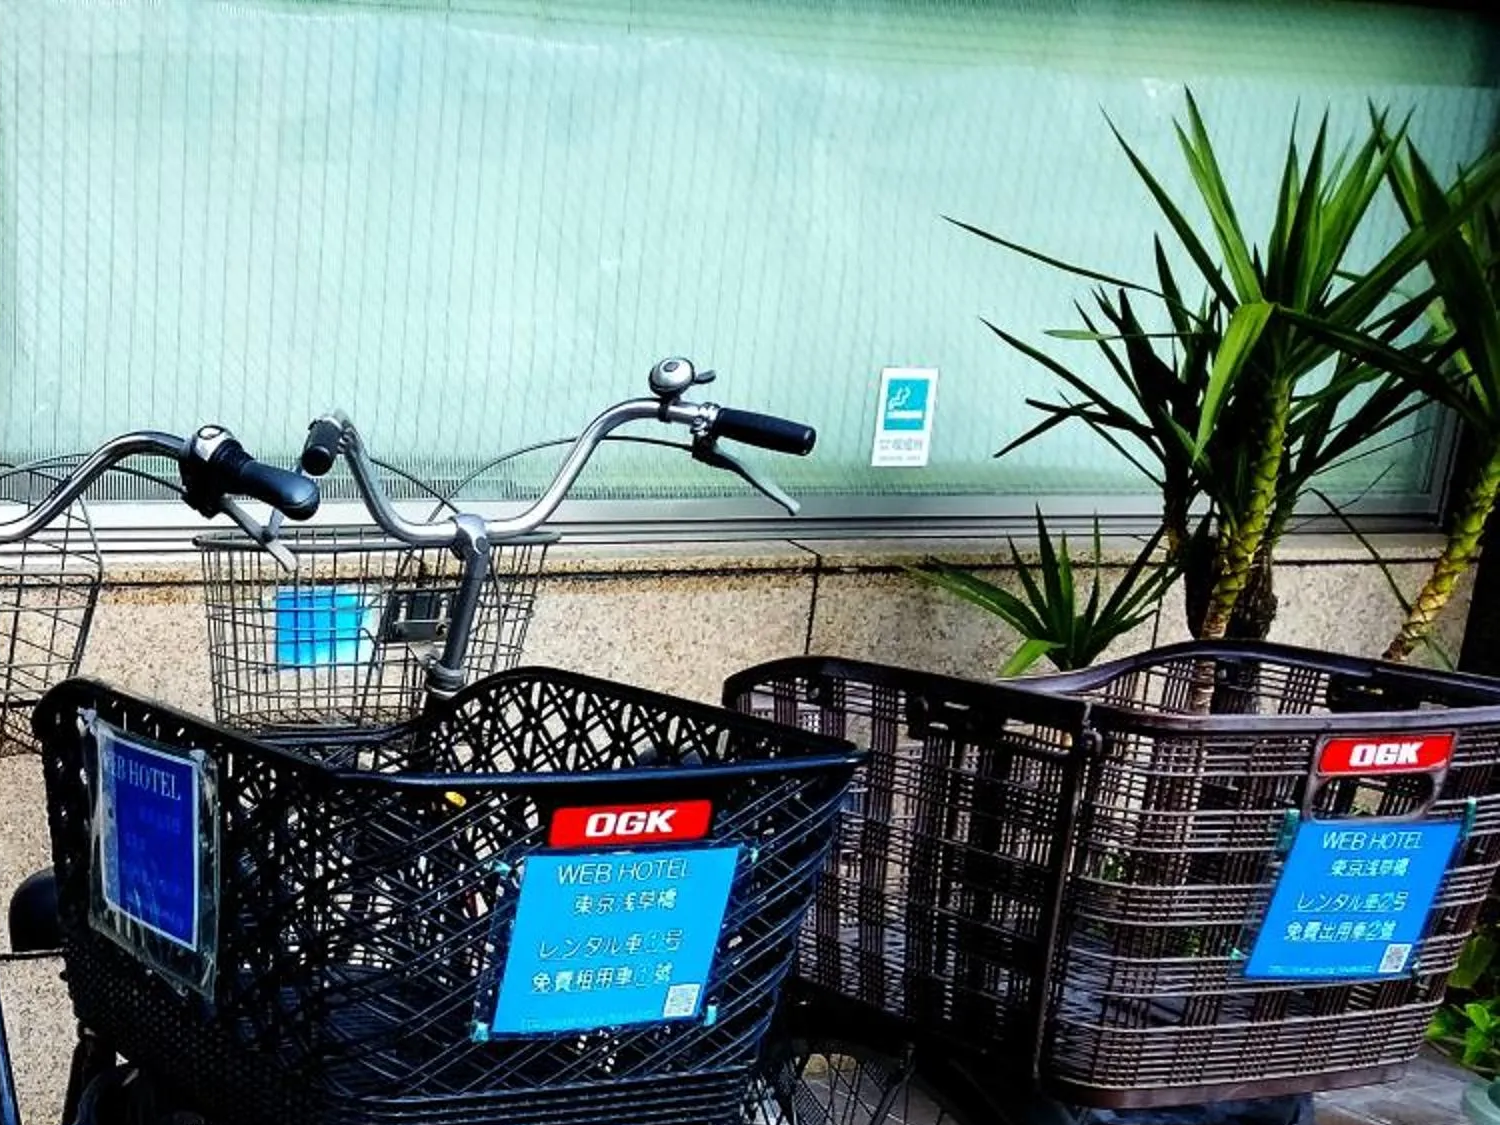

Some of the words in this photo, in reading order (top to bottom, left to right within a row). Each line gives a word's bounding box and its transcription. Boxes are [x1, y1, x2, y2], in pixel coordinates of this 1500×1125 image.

[1349, 741, 1423, 767] OGK
[128, 760, 181, 800] HOTEL
[585, 808, 678, 838] OGK
[1322, 831, 1367, 851] WEB
[1368, 831, 1424, 850] HOTEL
[557, 862, 612, 886] WEB
[617, 857, 690, 884] HOTEL
